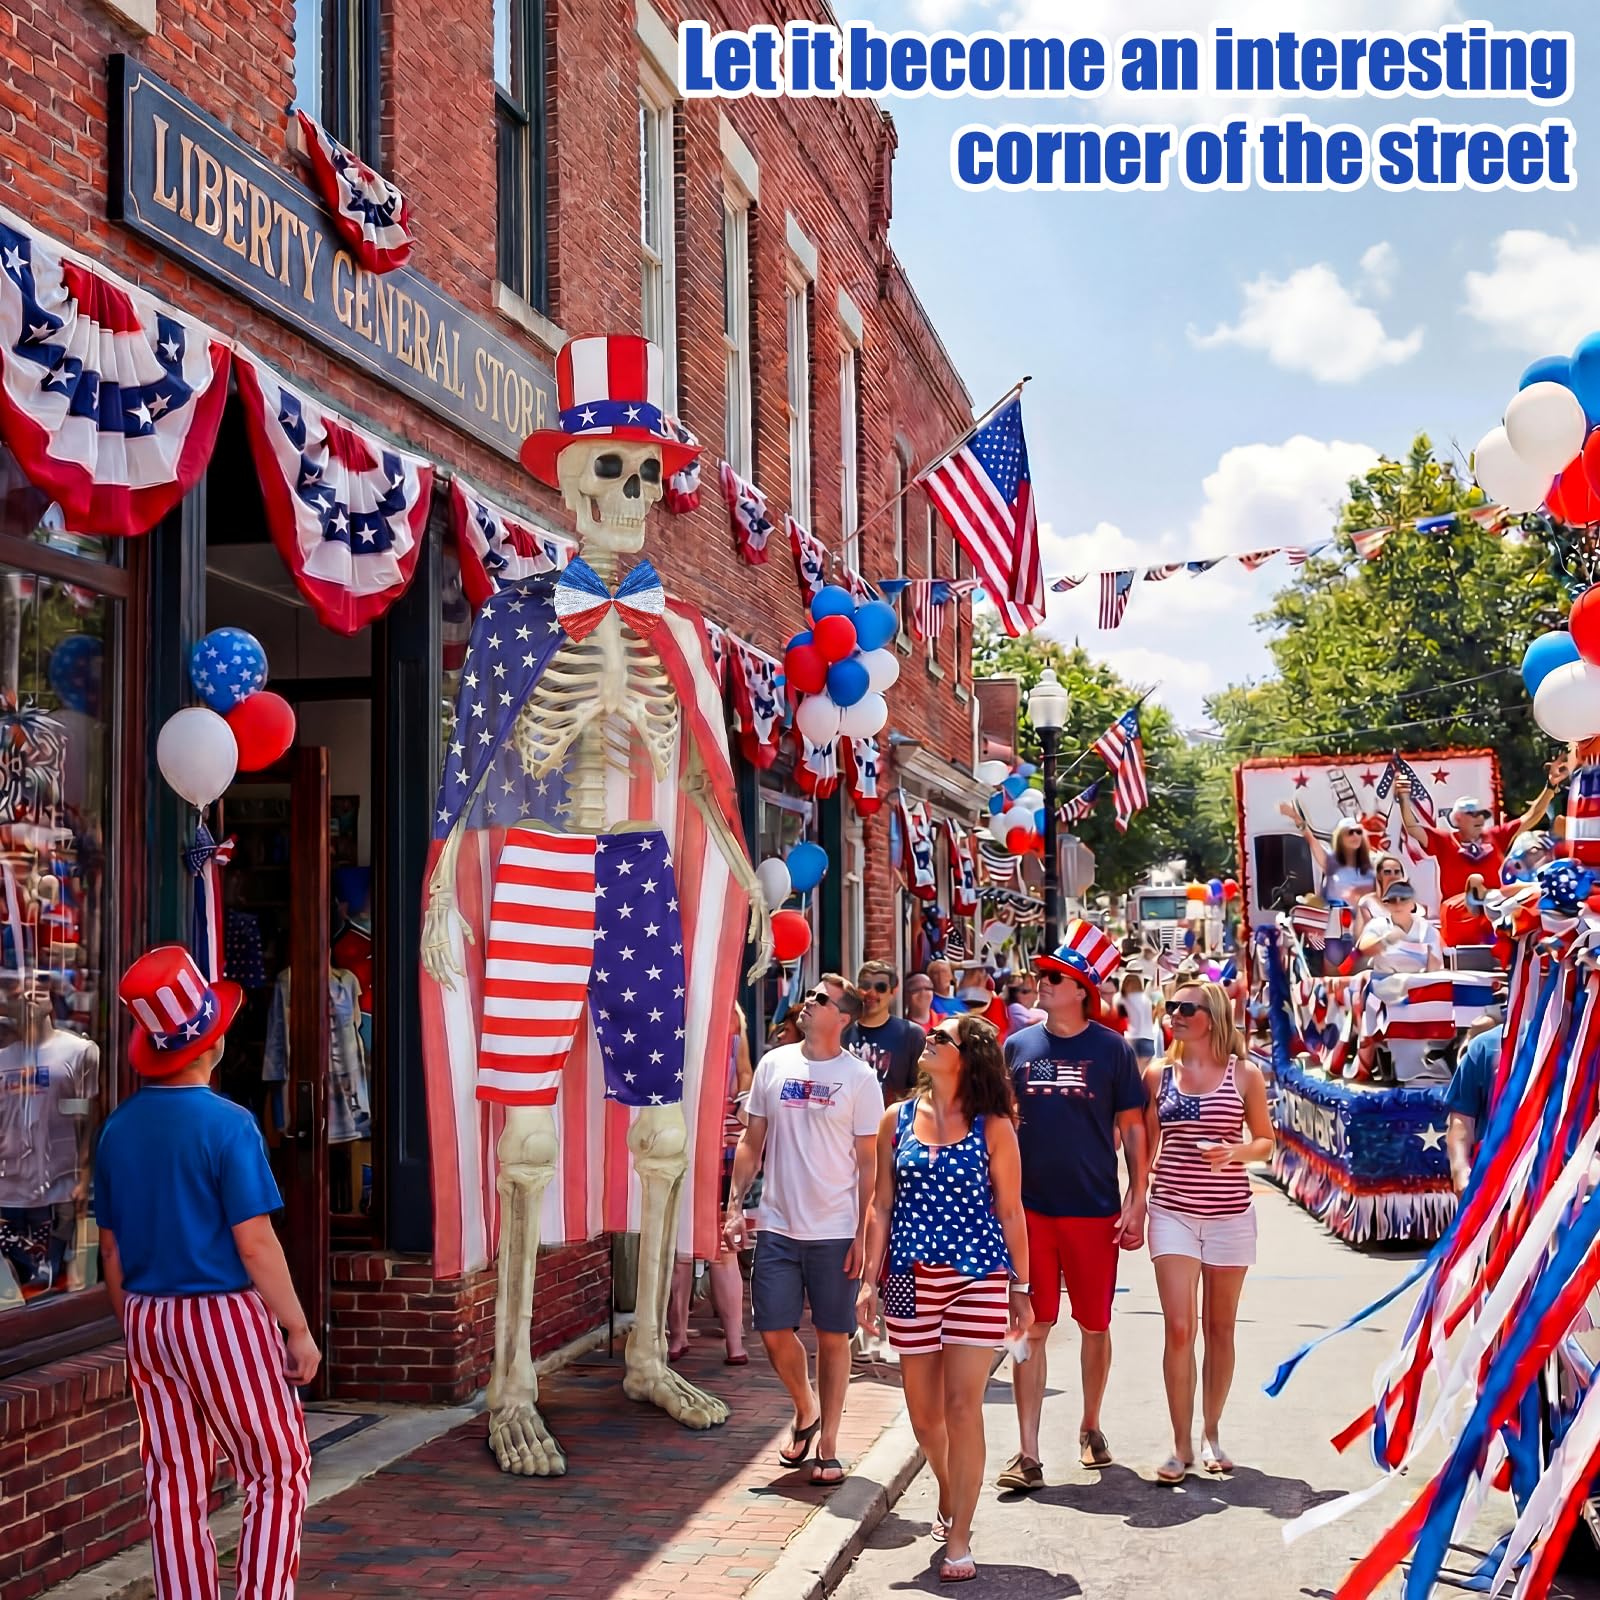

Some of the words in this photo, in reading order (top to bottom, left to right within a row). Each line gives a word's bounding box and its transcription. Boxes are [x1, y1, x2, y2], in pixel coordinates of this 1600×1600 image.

[152, 113, 324, 304] LIBERTY
[331, 249, 466, 400] GENERAL
[473, 346, 549, 441] STORE
